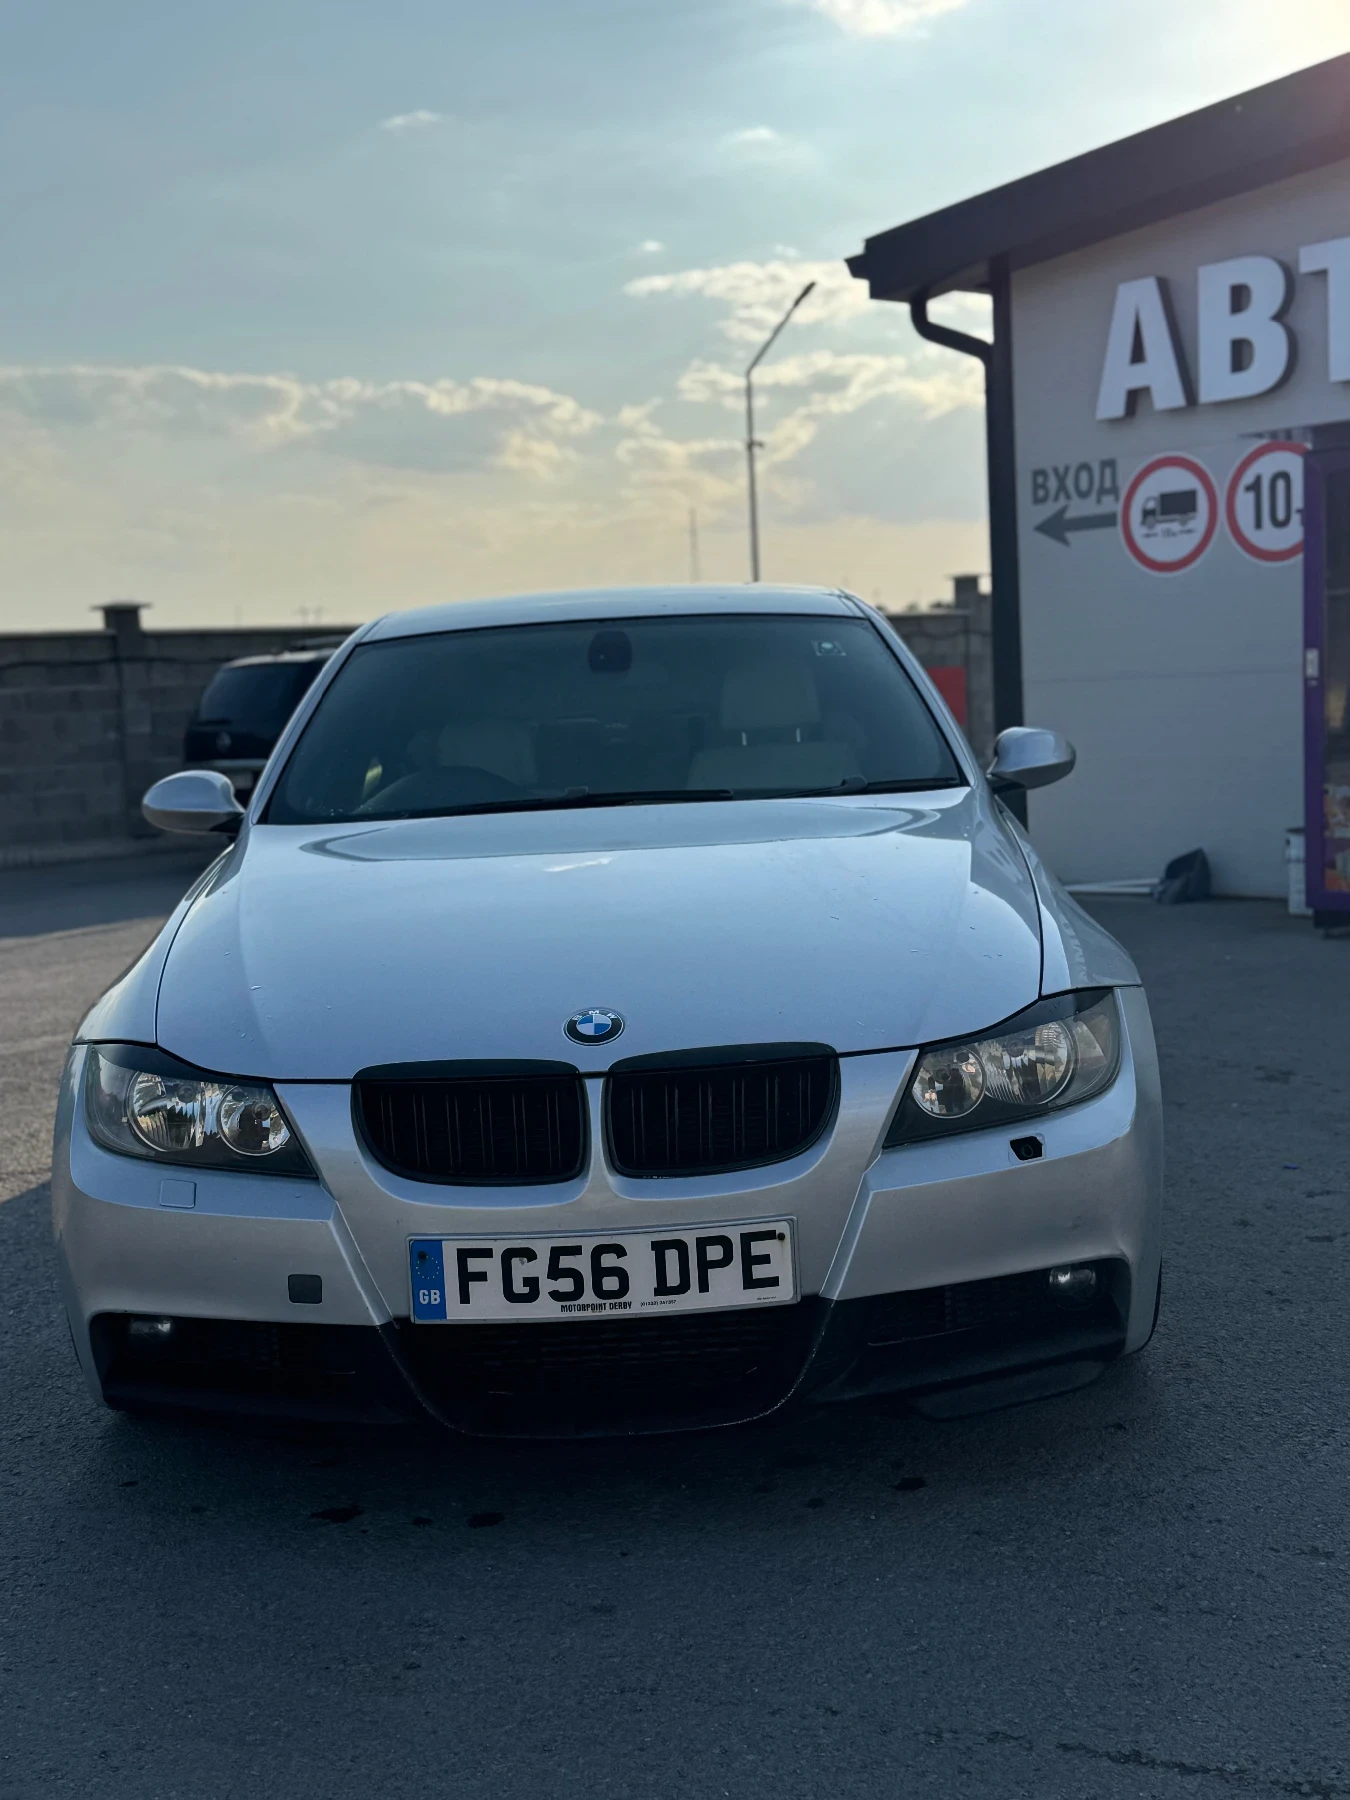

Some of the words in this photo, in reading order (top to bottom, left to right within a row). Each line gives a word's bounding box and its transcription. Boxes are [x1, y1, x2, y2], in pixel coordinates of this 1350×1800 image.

[1032, 458, 1120, 505] ВХОД
[1244, 470, 1304, 530] 10
[456, 1243, 630, 1304] FG56
[651, 1229, 780, 1297] DPE
[419, 1289, 441, 1305] GB
[560, 1302, 607, 1313] MOTORPOINT
[609, 1301, 632, 1311] DERBY
